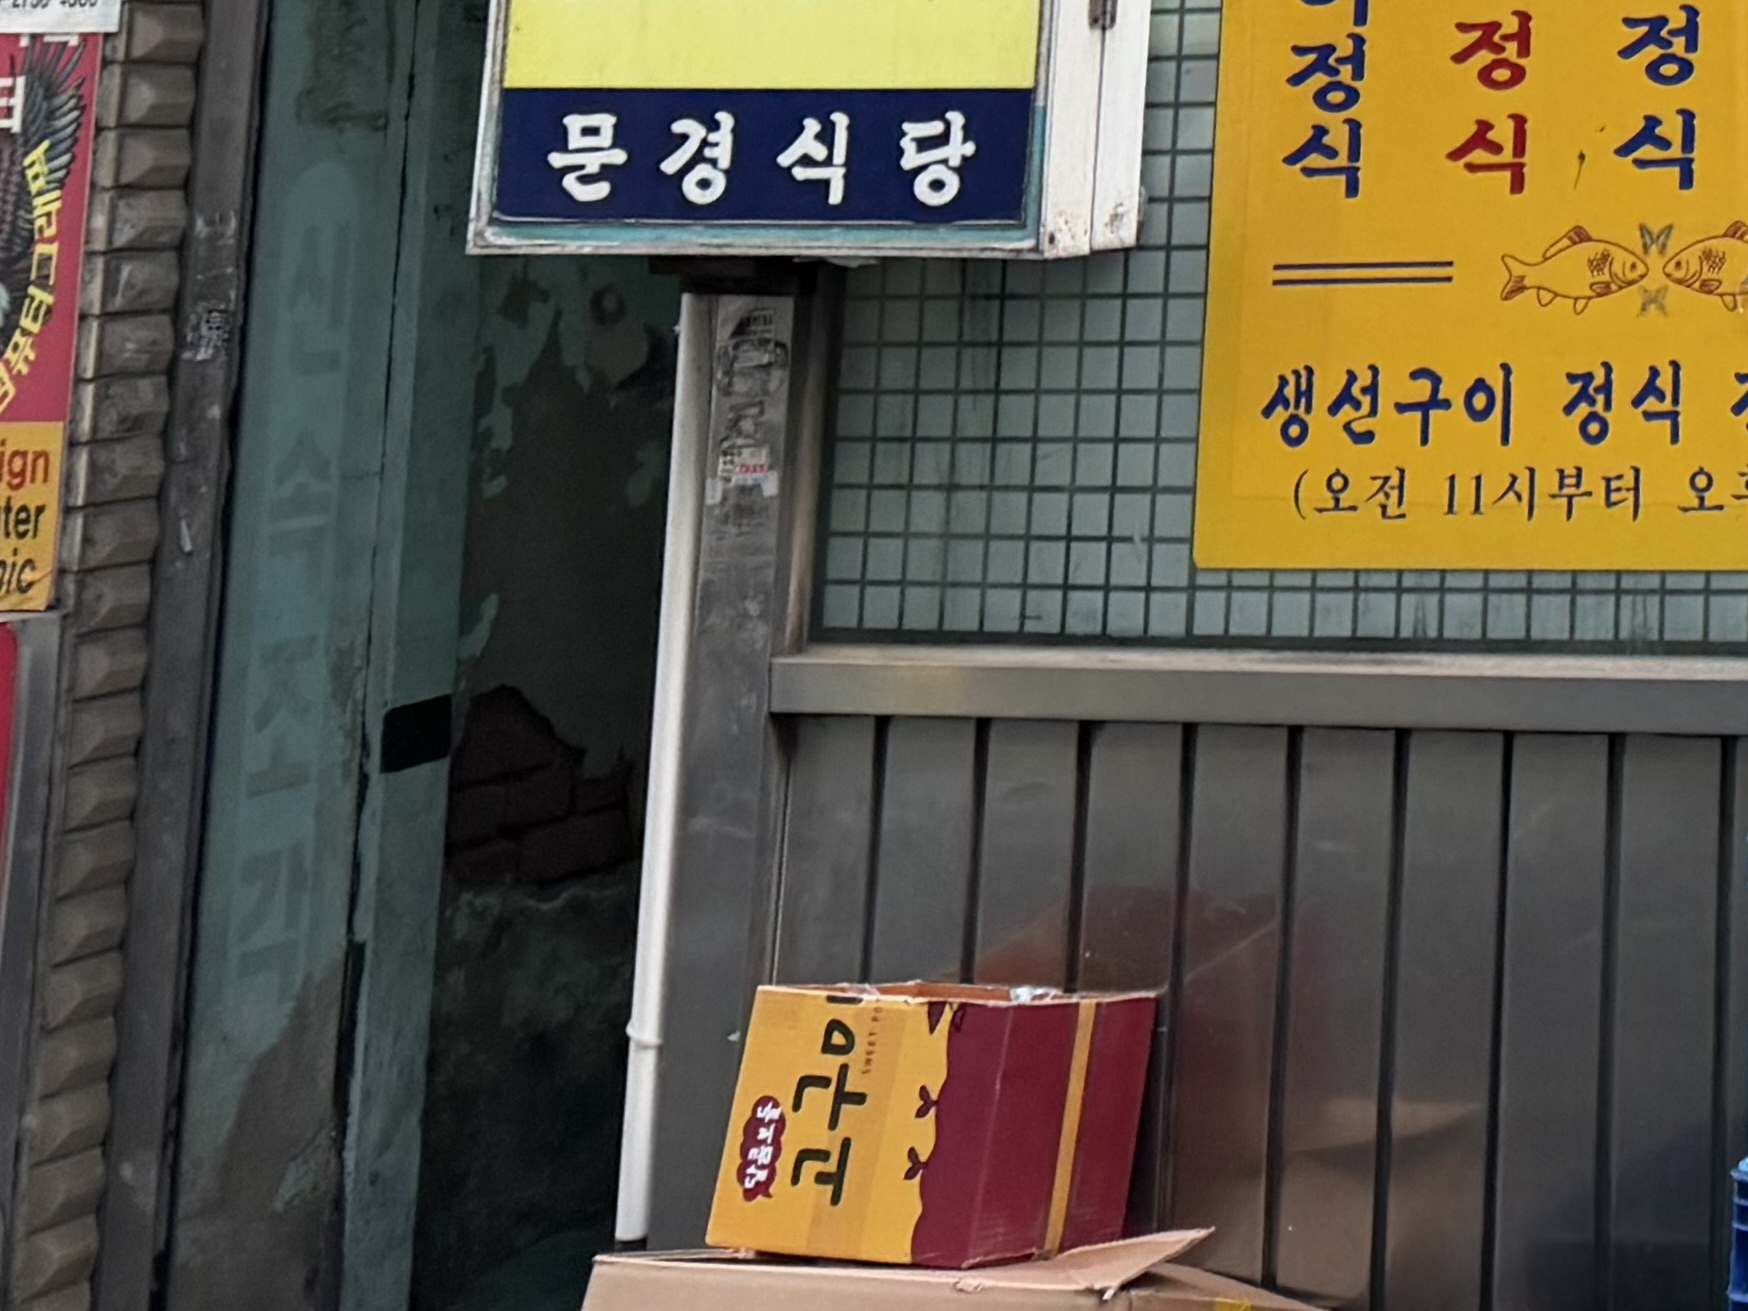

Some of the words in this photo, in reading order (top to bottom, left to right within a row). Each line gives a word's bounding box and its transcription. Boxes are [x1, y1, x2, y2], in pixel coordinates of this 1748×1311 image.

[547, 110, 976, 207] 문경식당
[1260, 363, 1513, 448] 생선구이
[1563, 360, 1682, 446] 정식
[0, 496, 46, 540] ter
[1293, 466, 1408, 523] (오전
[1442, 464, 1643, 522] 11시부터
